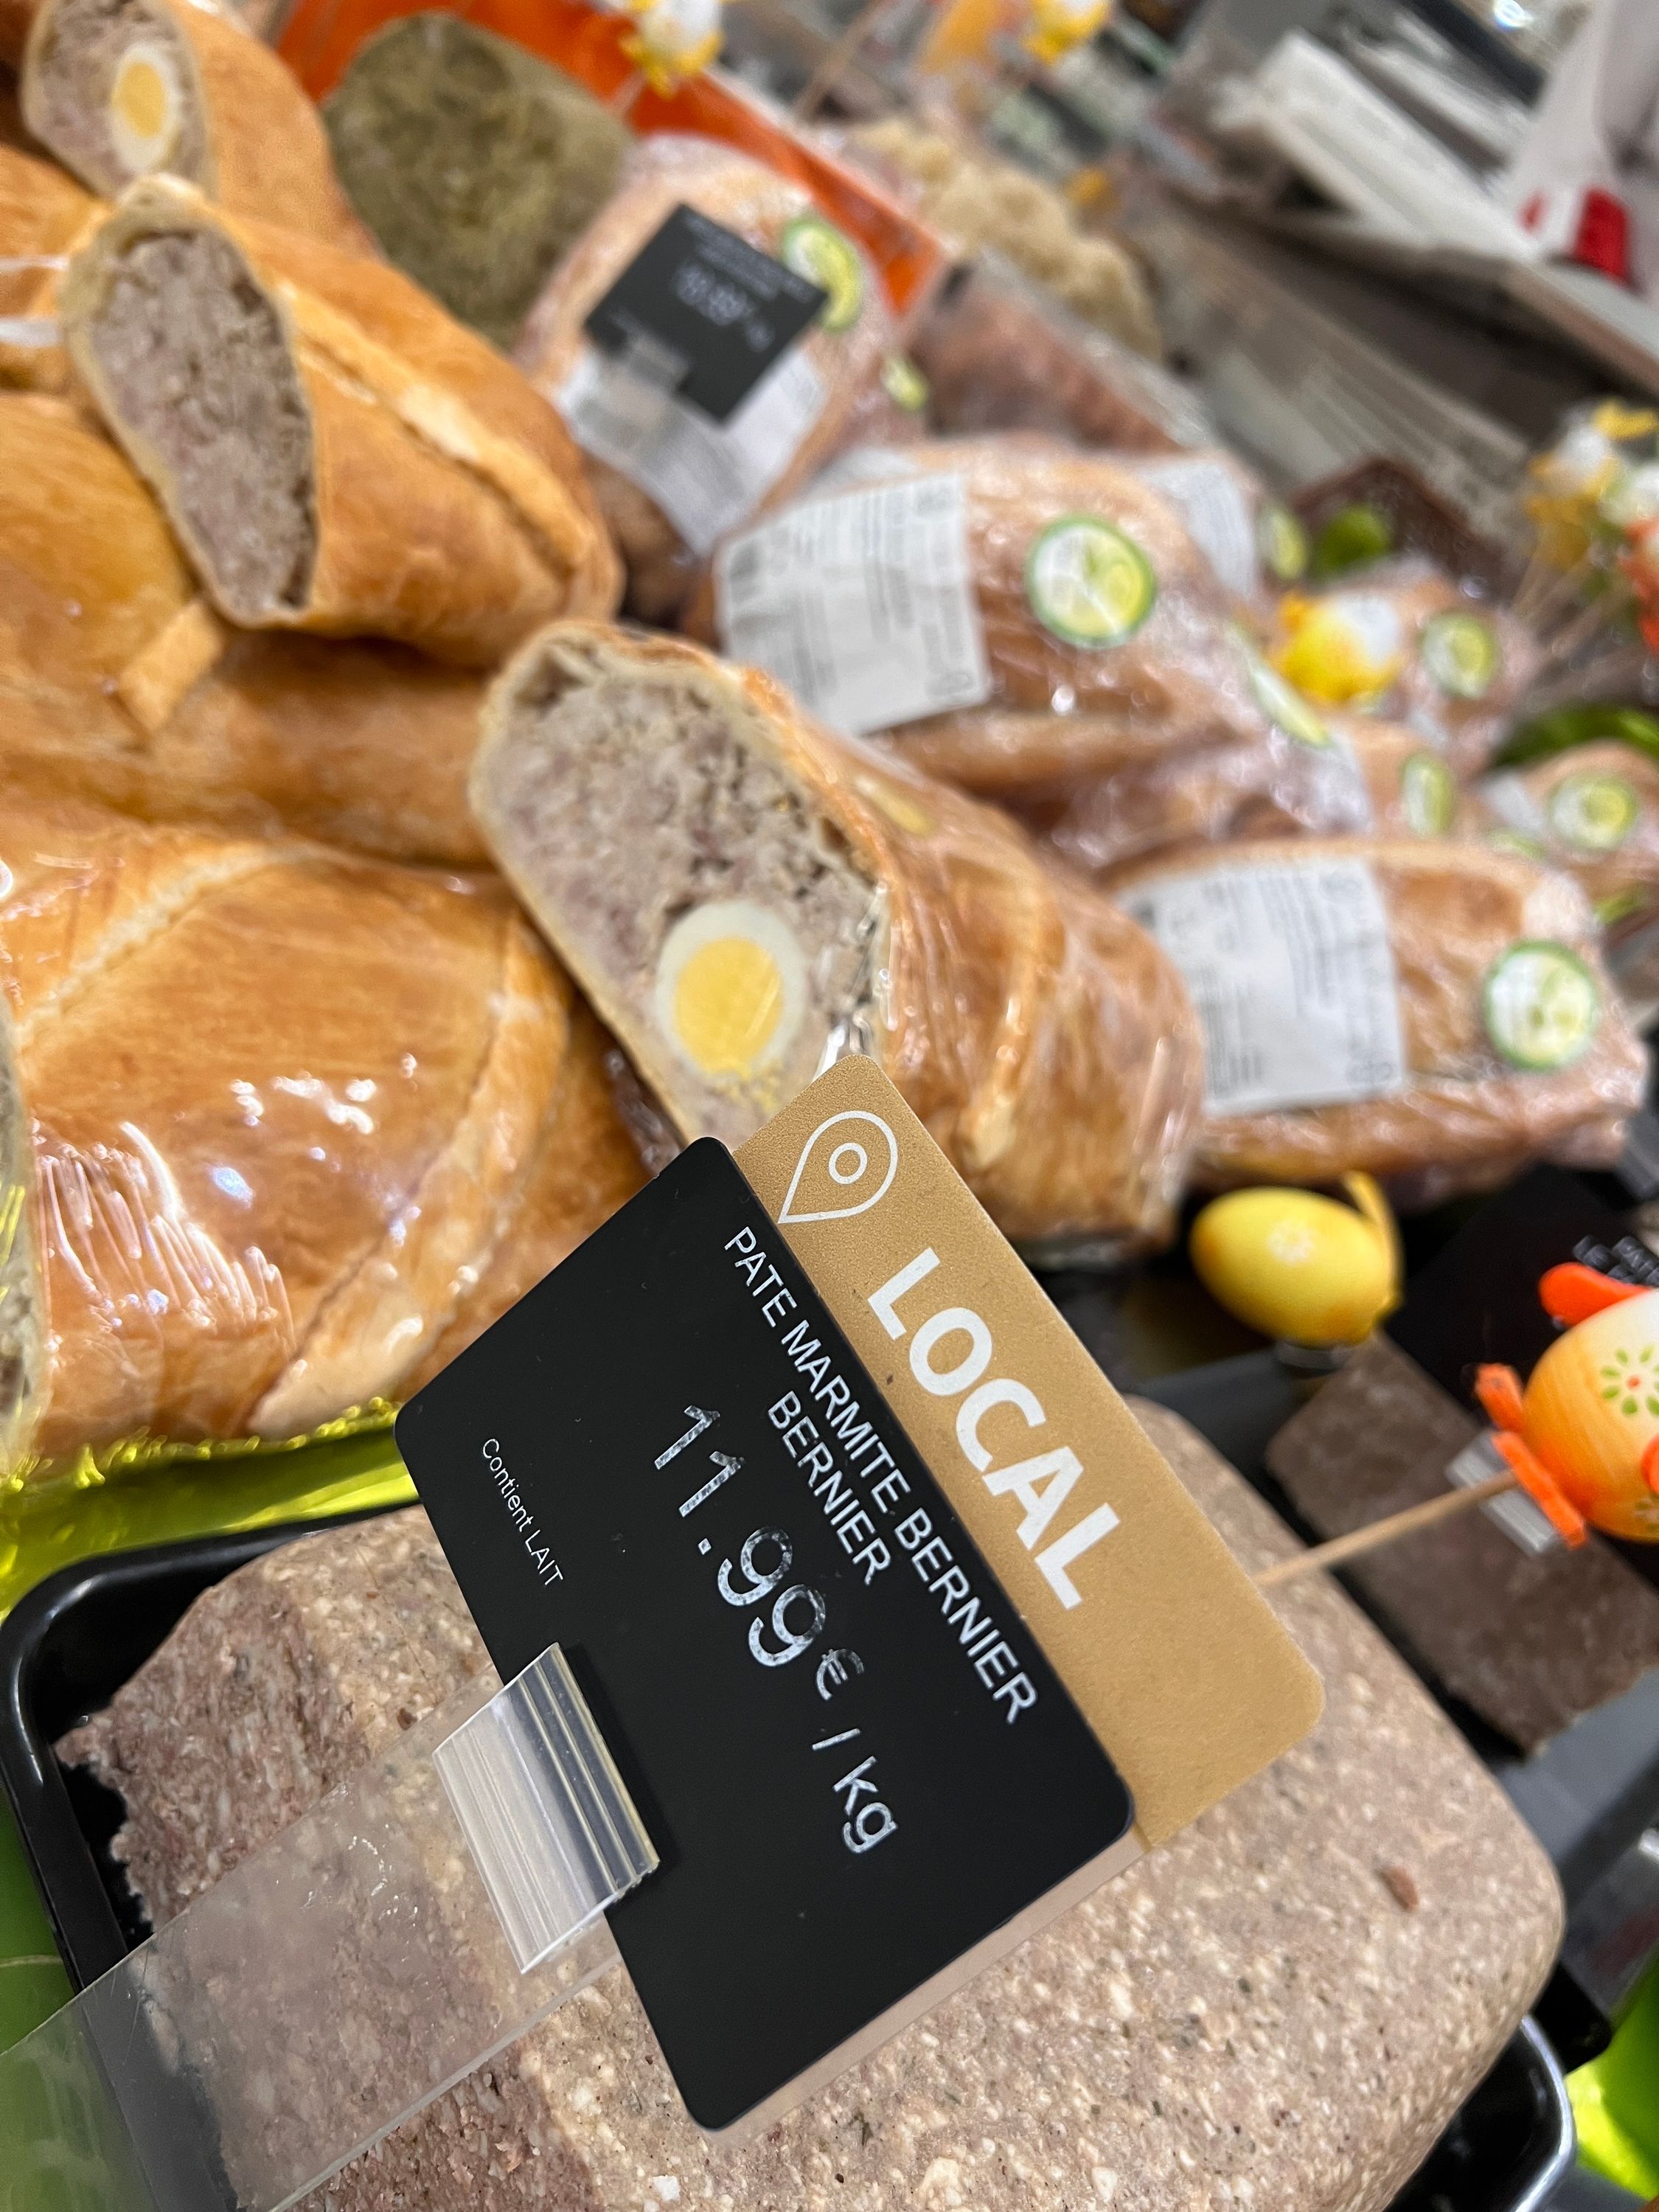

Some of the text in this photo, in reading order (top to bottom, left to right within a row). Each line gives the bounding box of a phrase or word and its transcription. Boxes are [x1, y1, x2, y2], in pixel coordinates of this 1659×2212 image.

[483, 1439, 563, 1585] Contient LAIT
[725, 1226, 1036, 1723] PATE MARMITE BERNIER
[768, 1391, 891, 1585] BERNIER
[867, 1248, 1121, 1610] LOCAL
